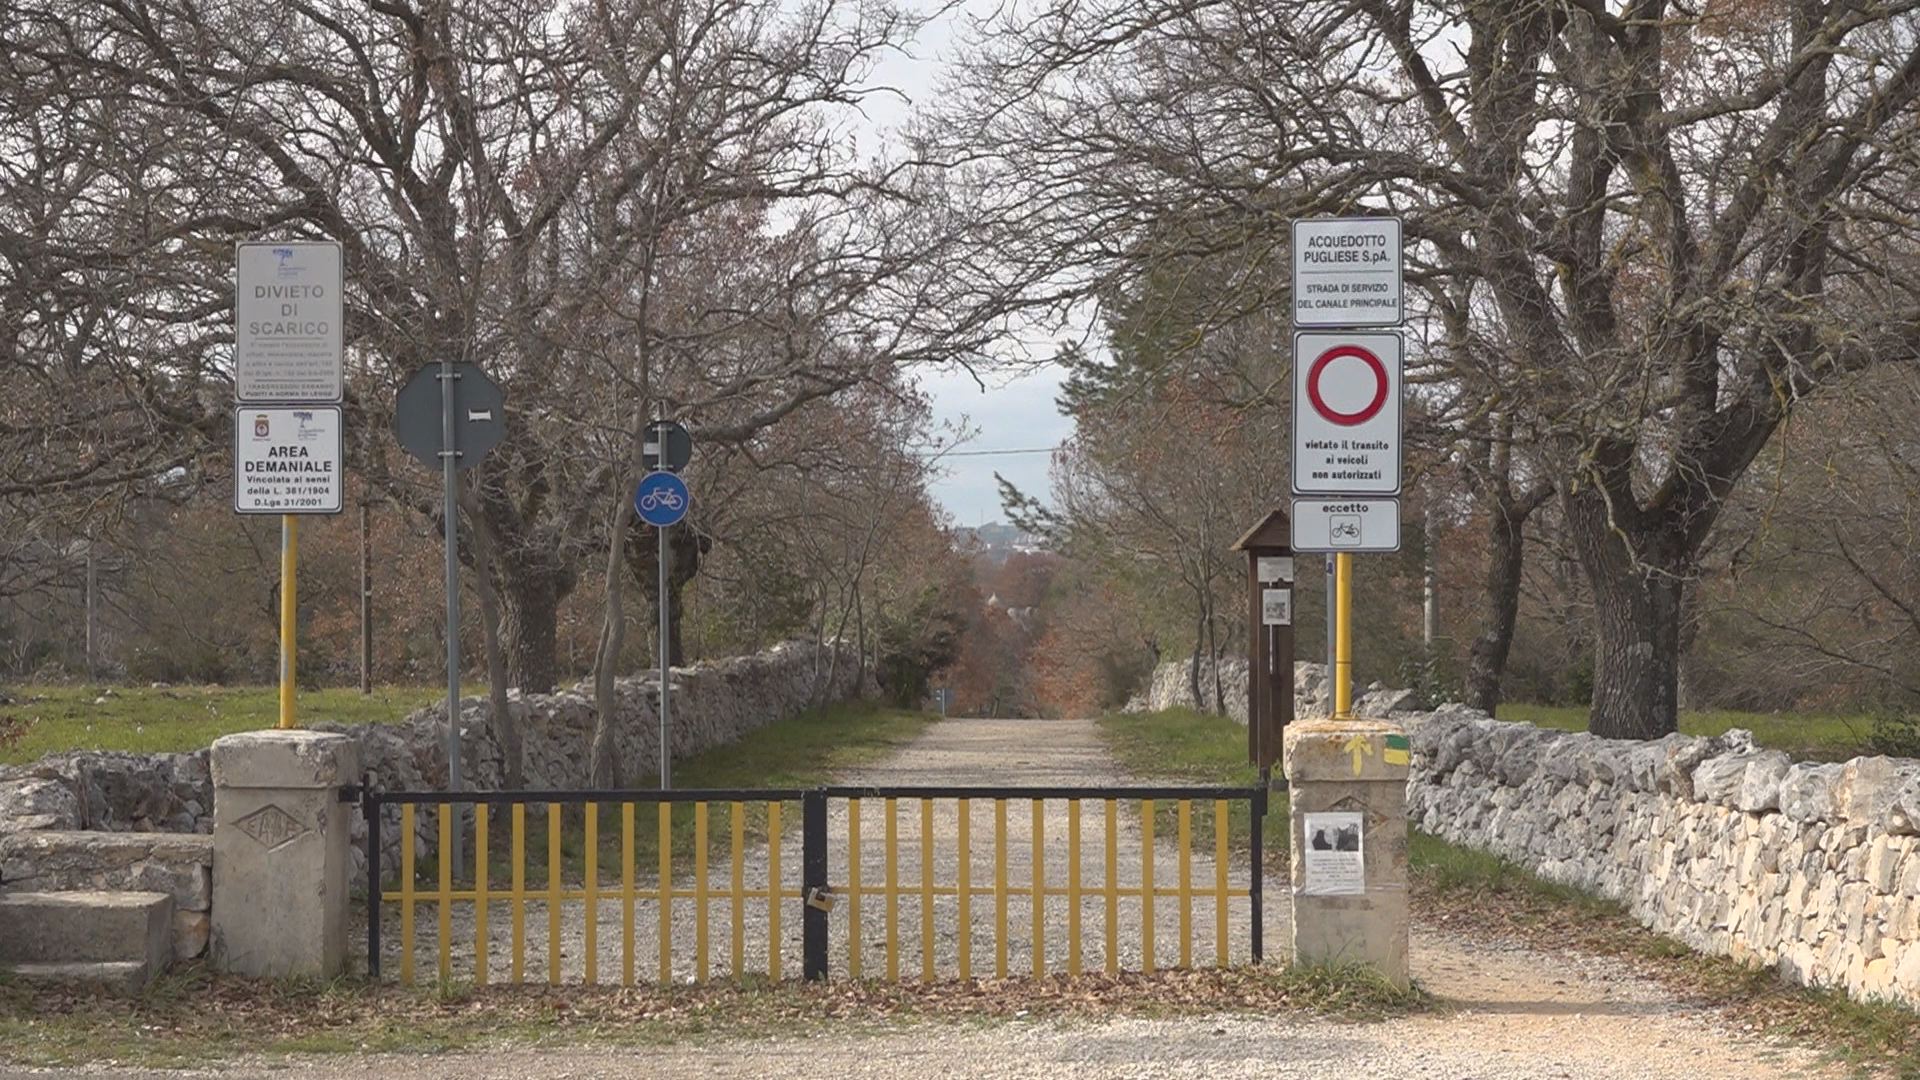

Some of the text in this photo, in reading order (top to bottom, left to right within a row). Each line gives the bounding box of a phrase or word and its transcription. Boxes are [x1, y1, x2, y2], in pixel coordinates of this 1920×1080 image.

[1308, 235, 1386, 248] ACQUEDOTTO
[1304, 250, 1359, 263] PUGLIESE
[255, 285, 324, 298] DIVIETO
[1306, 283, 1388, 293] STRADA DI SERVIZIO
[1298, 298, 1397, 309] DEL CANALE PRINCIPALE
[281, 304, 298, 316] DI
[249, 322, 329, 336] SCARICO
[1305, 440, 1389, 450] vietato il transito
[268, 446, 309, 458] AREA
[1325, 455, 1369, 465] ai veicoli
[245, 461, 332, 472] DEMANIALE
[247, 475, 291, 484] Vincolata
[305, 475, 330, 484] sensi
[1312, 470, 1382, 480] non autorizzati
[247, 486, 270, 495] della
[284, 499, 322, 507] 31/2001
[1322, 503, 1369, 514] eccetto
